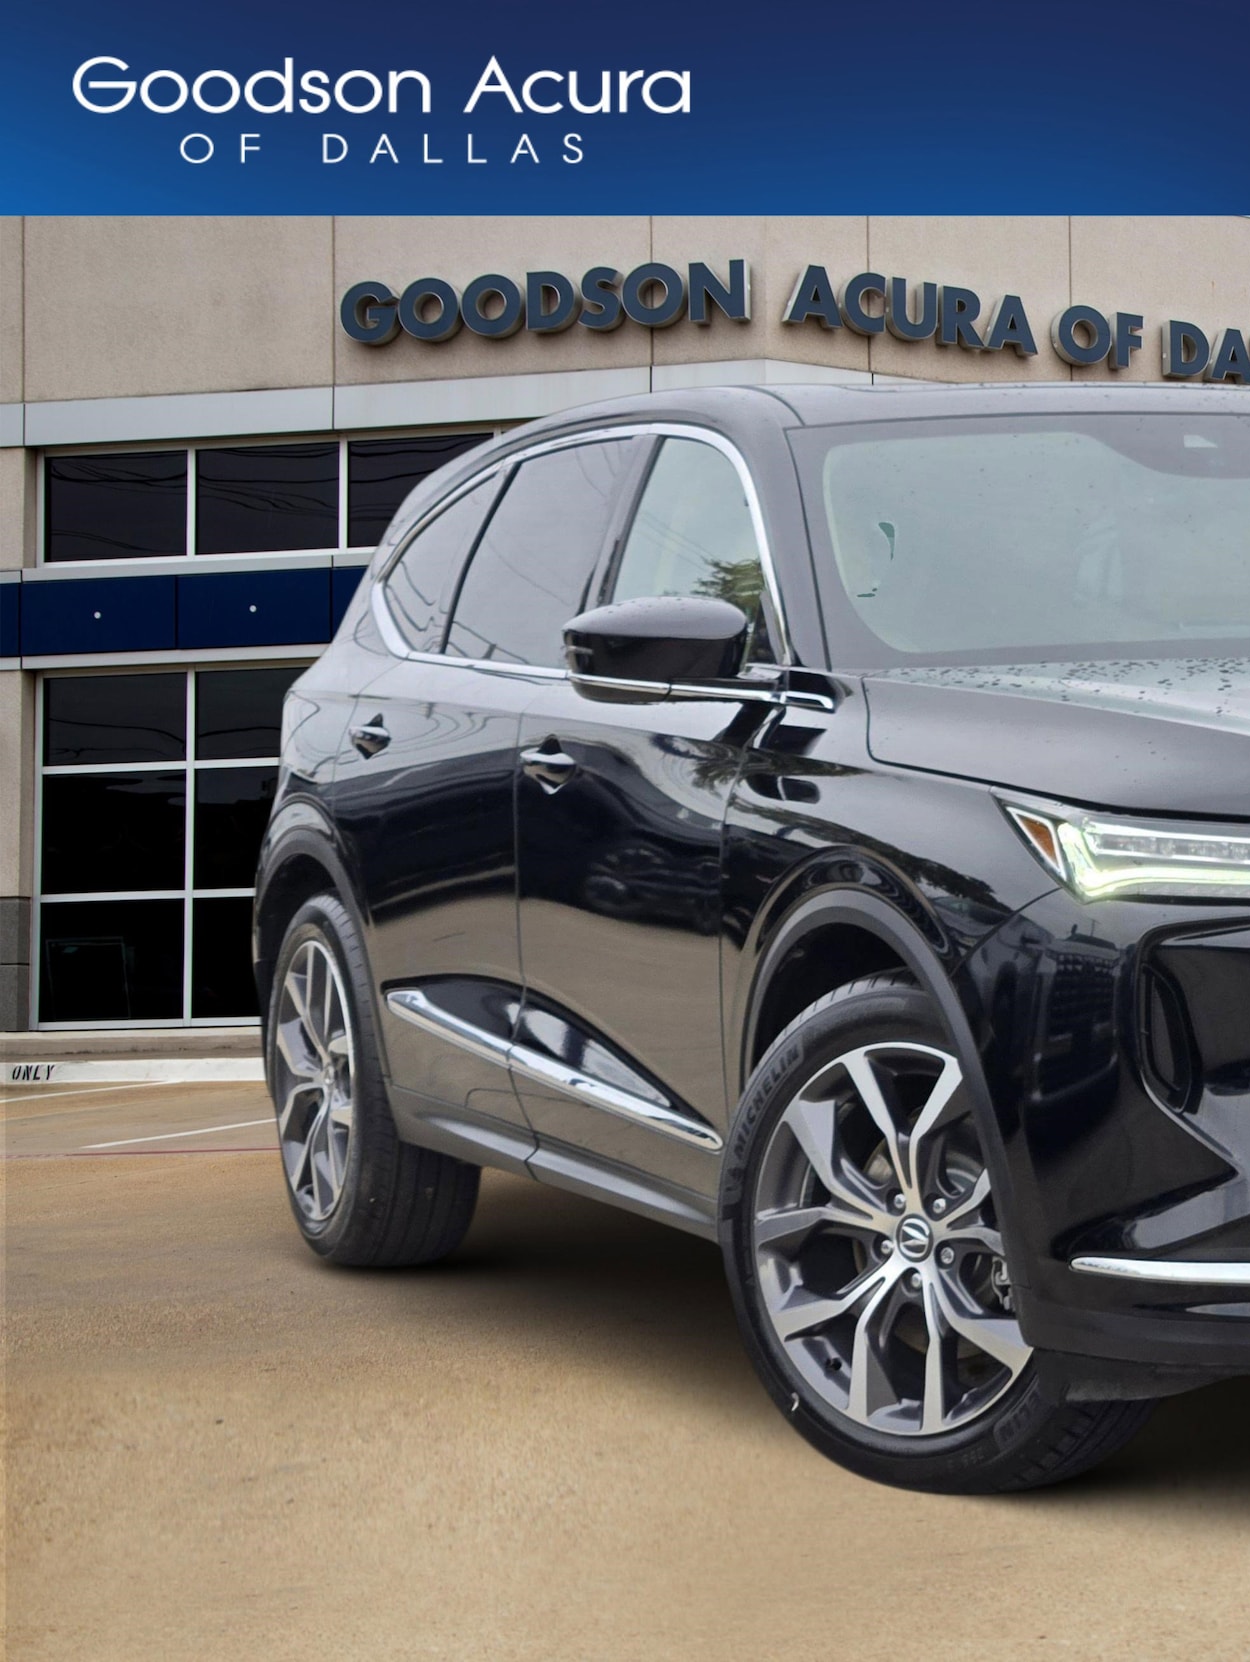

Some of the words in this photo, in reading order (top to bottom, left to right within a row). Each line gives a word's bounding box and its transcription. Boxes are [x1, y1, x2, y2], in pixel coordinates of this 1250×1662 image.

[340, 258, 752, 347] GOODSON
[782, 264, 1037, 357] ACURA
[1050, 304, 1144, 370] OF
[12, 1064, 55, 1080] ONLY
